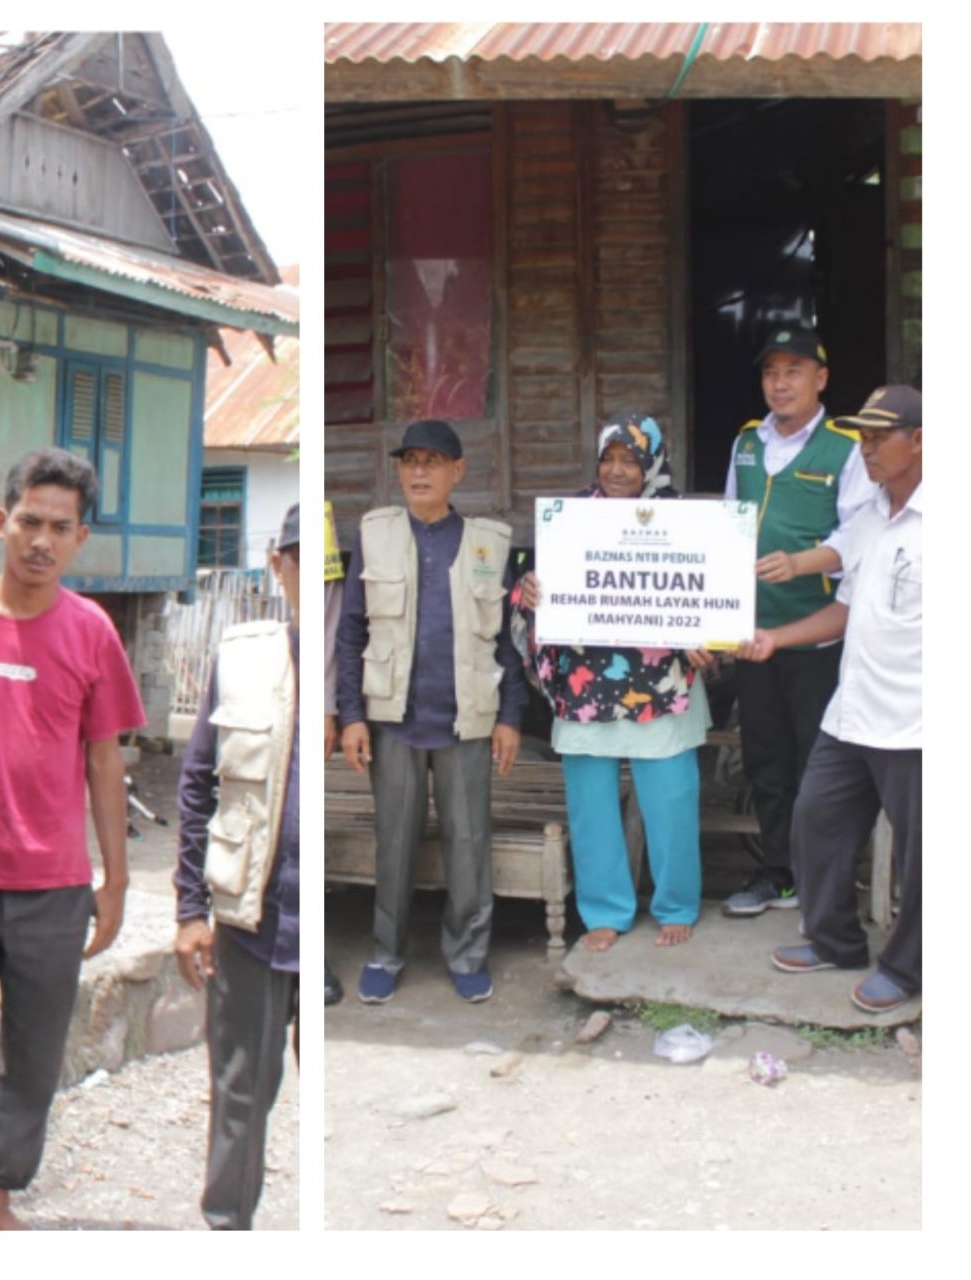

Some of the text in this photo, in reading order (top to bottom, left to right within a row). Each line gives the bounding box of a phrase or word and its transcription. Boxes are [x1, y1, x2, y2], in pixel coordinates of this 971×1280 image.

[585, 550, 706, 564] BAZNAS NTB PEDULI
[585, 570, 705, 592] BANTUAN
[551, 594, 740, 610] REHAB RUMAH LAYAK HUNI
[588, 613, 701, 628] (MAHYANI) 2022
